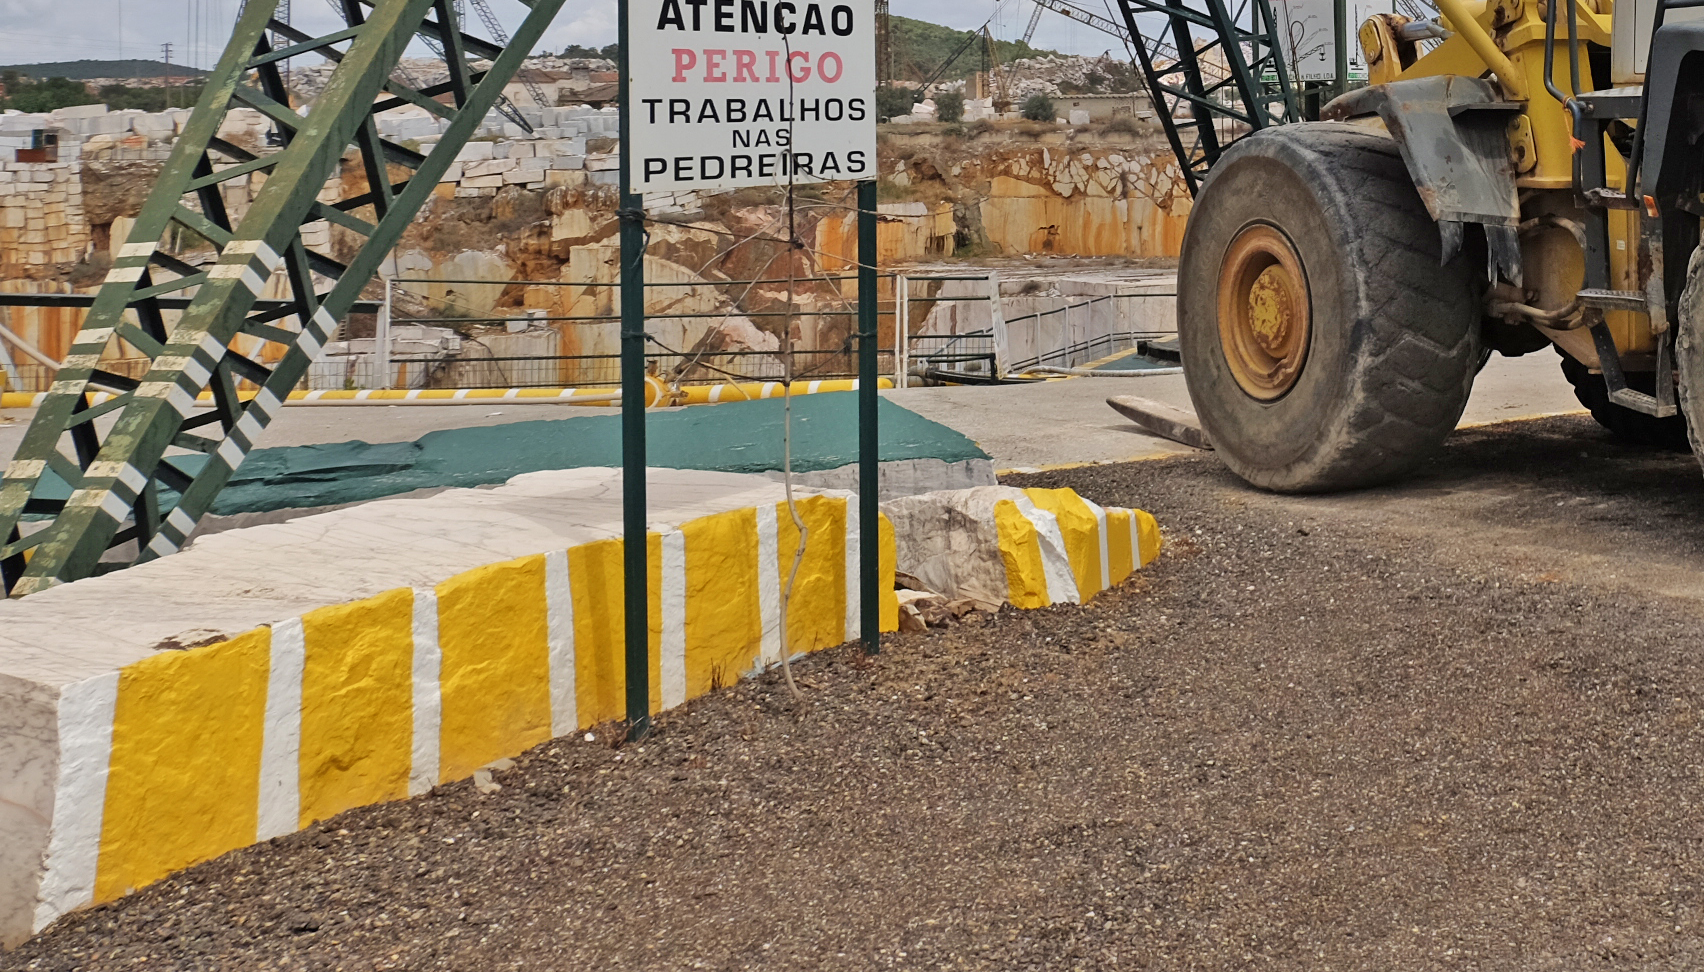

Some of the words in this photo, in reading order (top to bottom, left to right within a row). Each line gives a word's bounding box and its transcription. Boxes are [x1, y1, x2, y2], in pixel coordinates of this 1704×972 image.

[671, 48, 844, 84] PERIGO
[642, 97, 866, 125] TRABALHOS
[732, 128, 790, 149] NAS
[644, 150, 866, 183] PEDREIRAS
